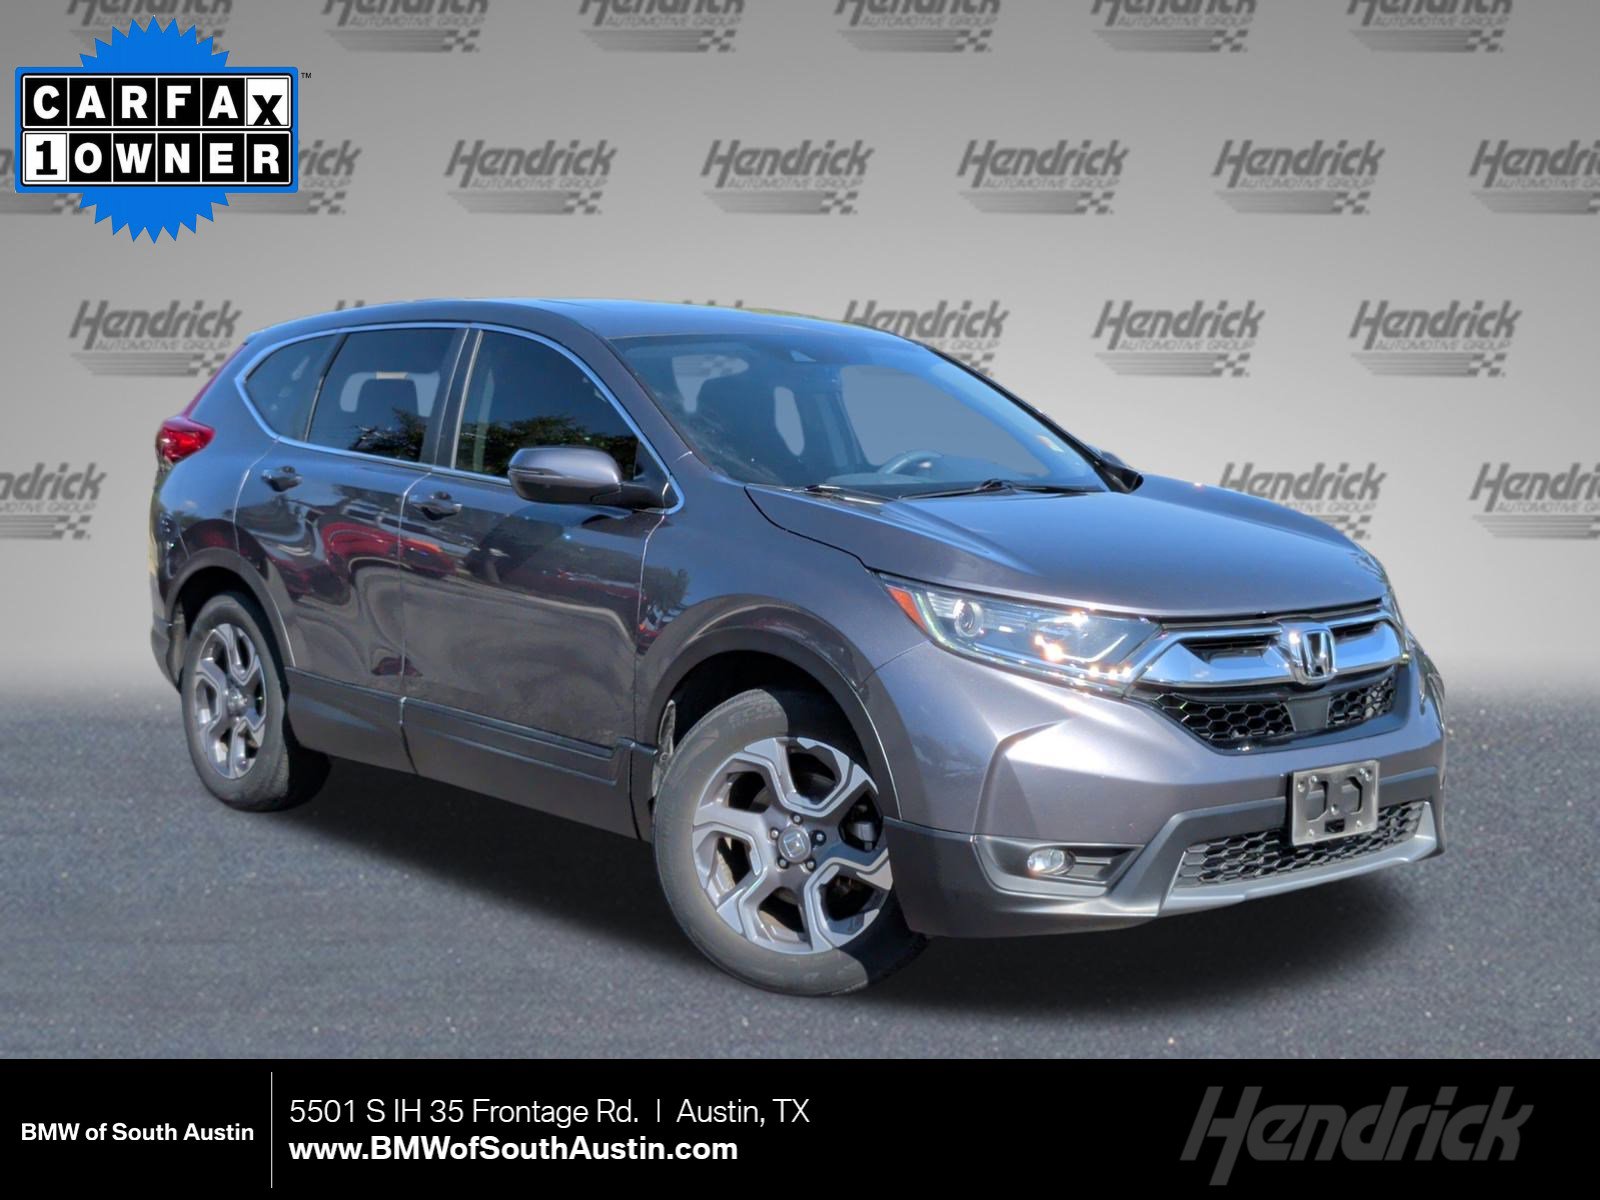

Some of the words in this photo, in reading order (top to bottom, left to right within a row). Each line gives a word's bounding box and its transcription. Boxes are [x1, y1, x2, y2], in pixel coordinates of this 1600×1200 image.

[443, 139, 617, 188] Hendrick
[699, 139, 873, 188] Hendrick
[955, 139, 1129, 188] Hendrick
[1211, 139, 1385, 188] Hendrick
[1469, 139, 1600, 188] Hendri
[69, 300, 242, 350] Hendrick
[1091, 300, 1265, 350] Hendrick
[1348, 300, 1522, 350] Hendrick
[0, 462, 107, 500] ndrick
[1470, 462, 1600, 512] Hendri
